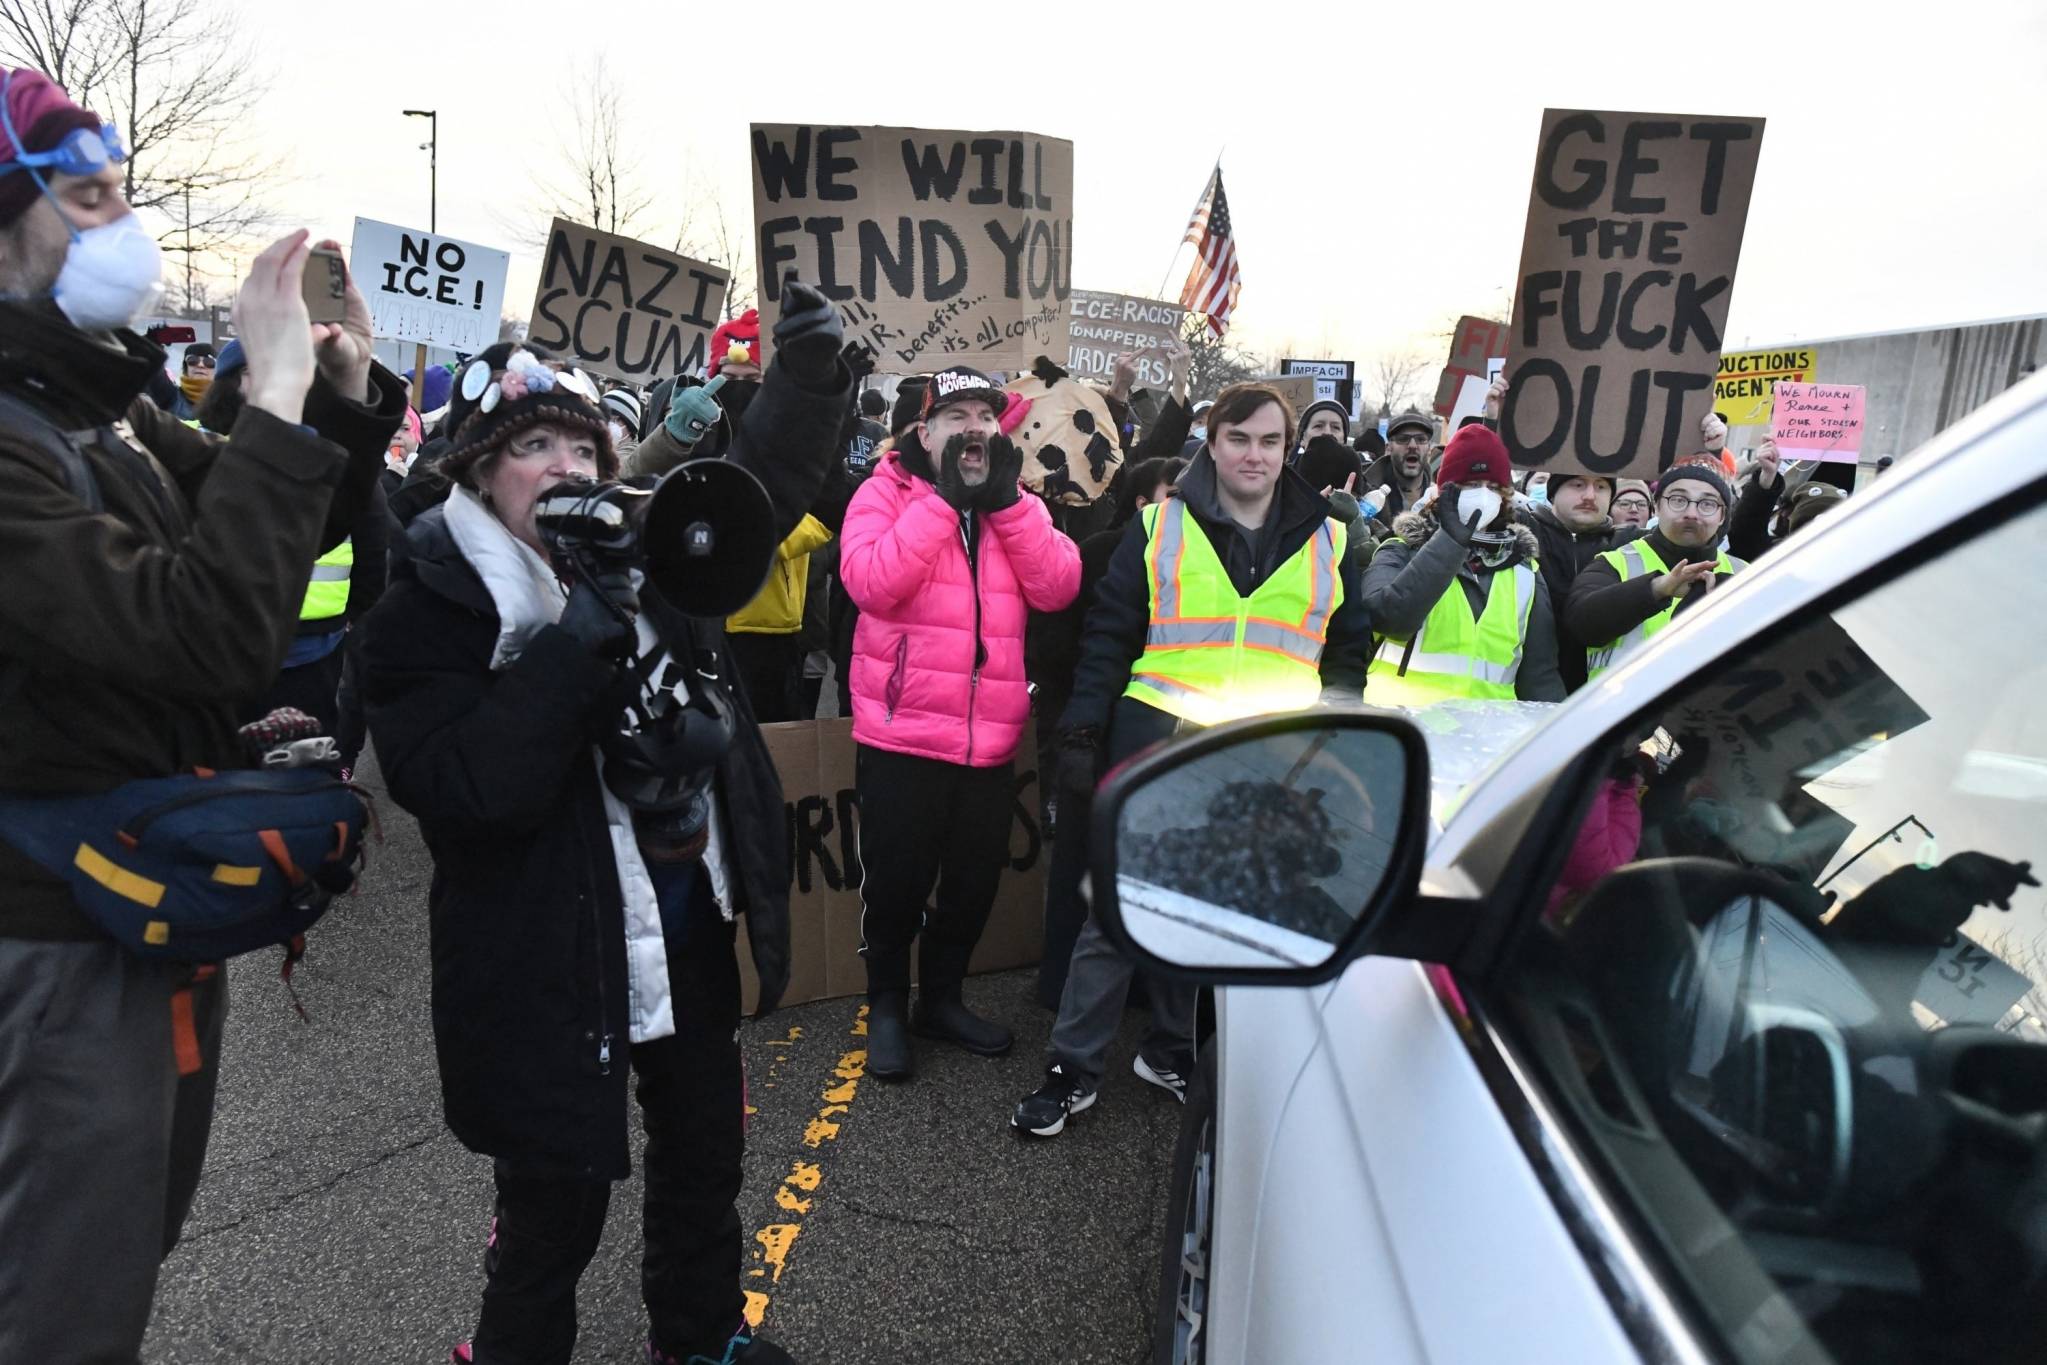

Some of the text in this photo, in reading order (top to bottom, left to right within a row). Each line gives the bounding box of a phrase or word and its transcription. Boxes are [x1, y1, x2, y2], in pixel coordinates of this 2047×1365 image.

[752, 126, 1052, 211] WE WILL
[1536, 113, 1752, 215] GET
[400, 233, 466, 273] NO
[760, 216, 1072, 302] FIND YOU
[1558, 217, 1688, 265] THE
[544, 230, 725, 330] NAZI
[531, 288, 705, 376] SCUM
[976, 315, 1000, 345] all
[1005, 303, 1062, 340] computer!
[1522, 270, 1730, 355] FUCK
[935, 371, 957, 383] The
[938, 375, 991, 397] MOVEMEN
[1067, 345, 1166, 385] URDERS
[1780, 385, 1850, 399] WE MOURN
[1499, 358, 1713, 474] OUT
[1788, 418, 1858, 427] OUR STOLEN
[694, 530, 708, 544] N
